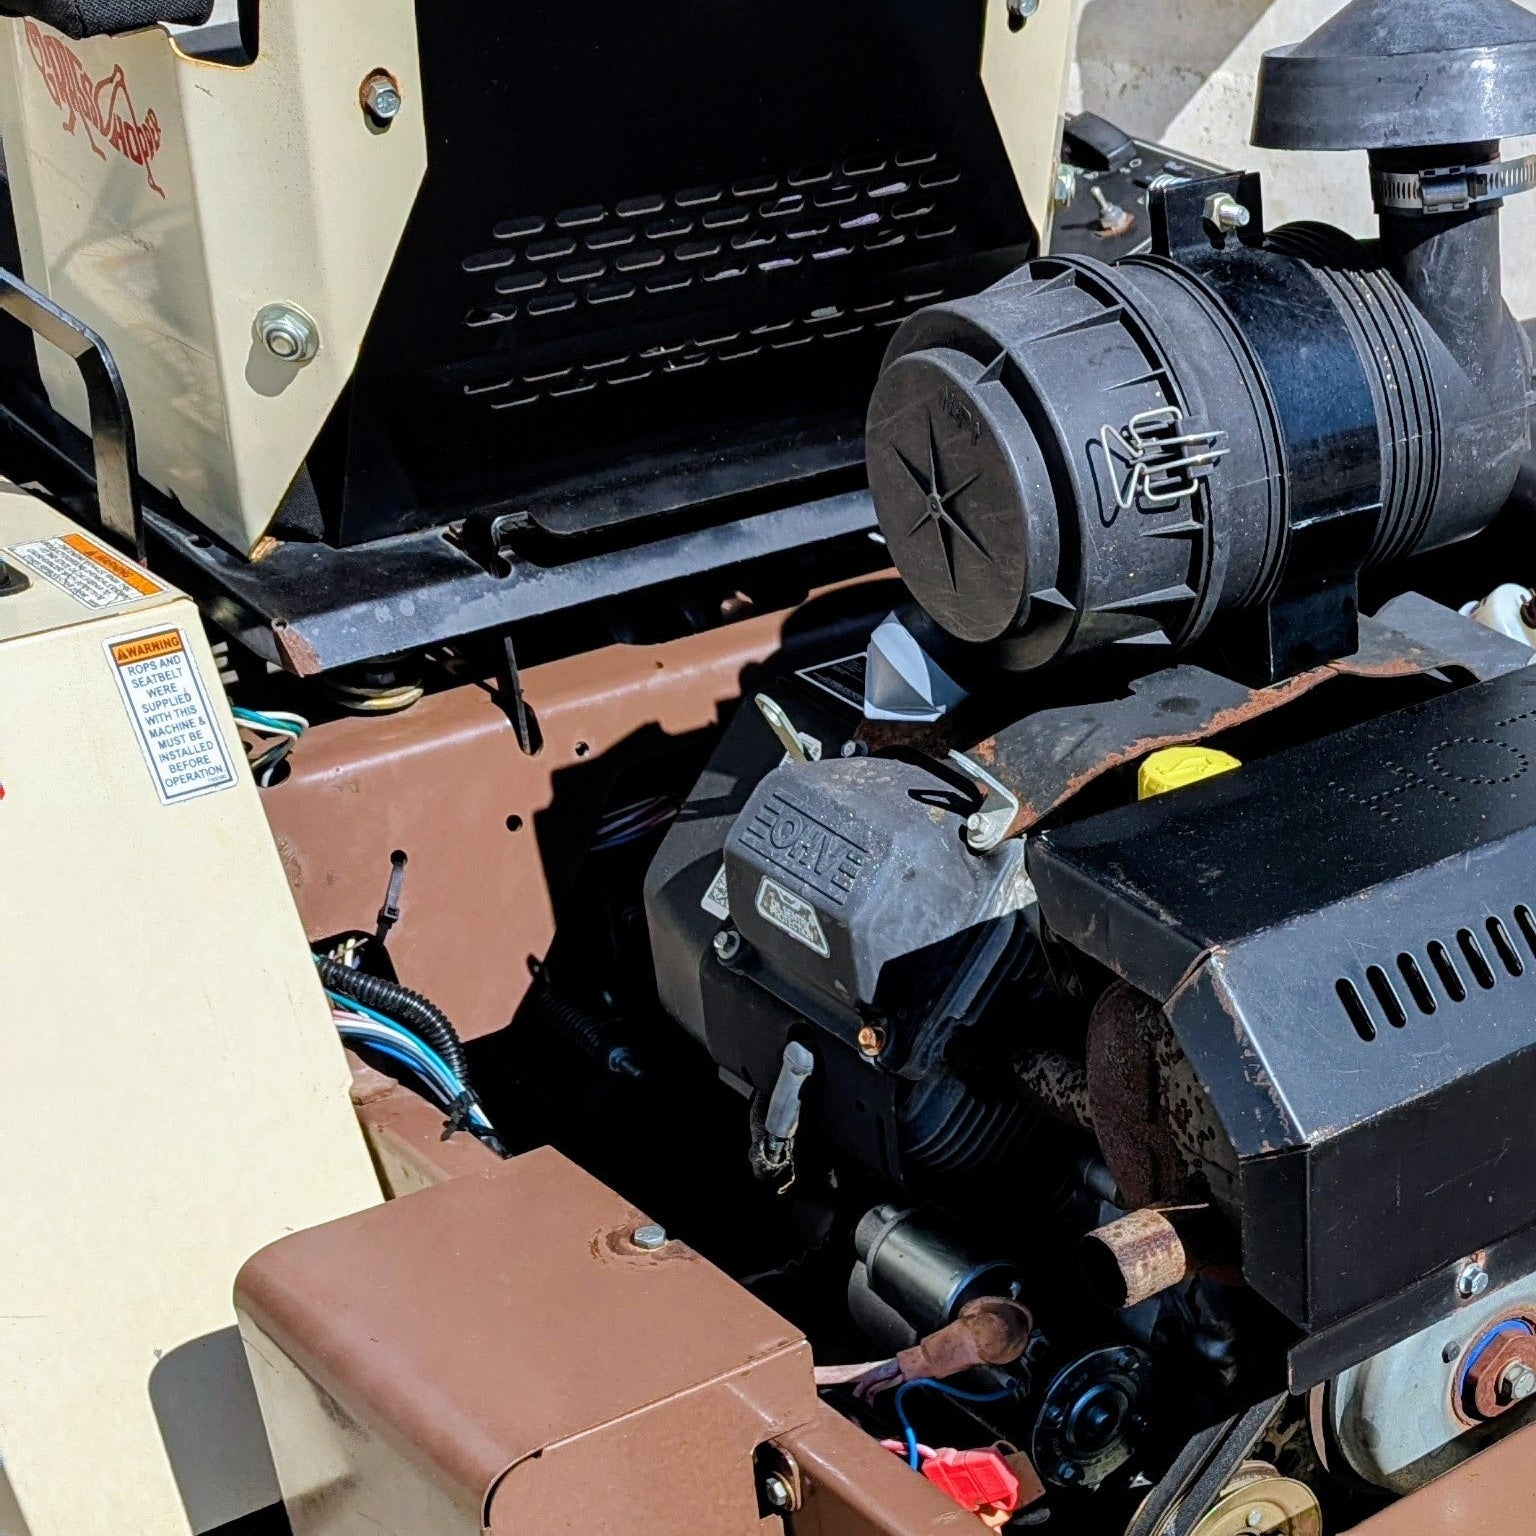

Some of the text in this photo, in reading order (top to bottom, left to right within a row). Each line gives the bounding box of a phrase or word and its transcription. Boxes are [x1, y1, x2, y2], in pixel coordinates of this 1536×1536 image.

[126, 636, 179, 655] WARNING
[128, 654, 181, 676] ROPS AND
[131, 668, 183, 688] SEATBELT
[146, 683, 178, 699] WERE
[141, 692, 192, 714] SUPPLIED
[145, 704, 197, 726] WITH THIS
[148, 716, 206, 739] MACHINE &
[158, 729, 204, 749] MUST BE
[159, 740, 214, 763] INSTALLED
[169, 754, 211, 774] BEFORE
[769, 813, 847, 877] OHV
